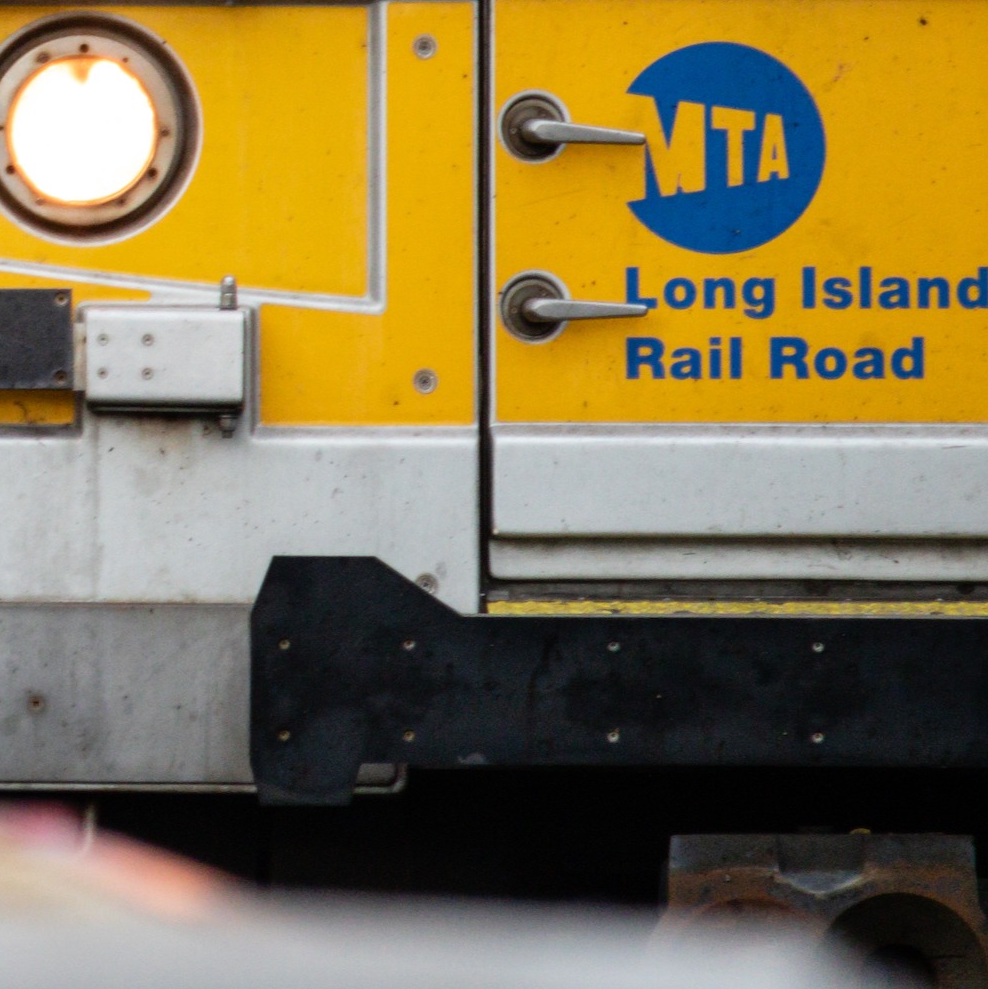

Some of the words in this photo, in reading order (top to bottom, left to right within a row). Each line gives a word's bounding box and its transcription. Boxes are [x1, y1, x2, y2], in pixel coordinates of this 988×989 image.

[627, 93, 789, 203] MTA
[625, 266, 776, 319] Long
[801, 266, 988, 310] Island
[625, 336, 743, 380] Rail
[769, 336, 925, 380] Road
